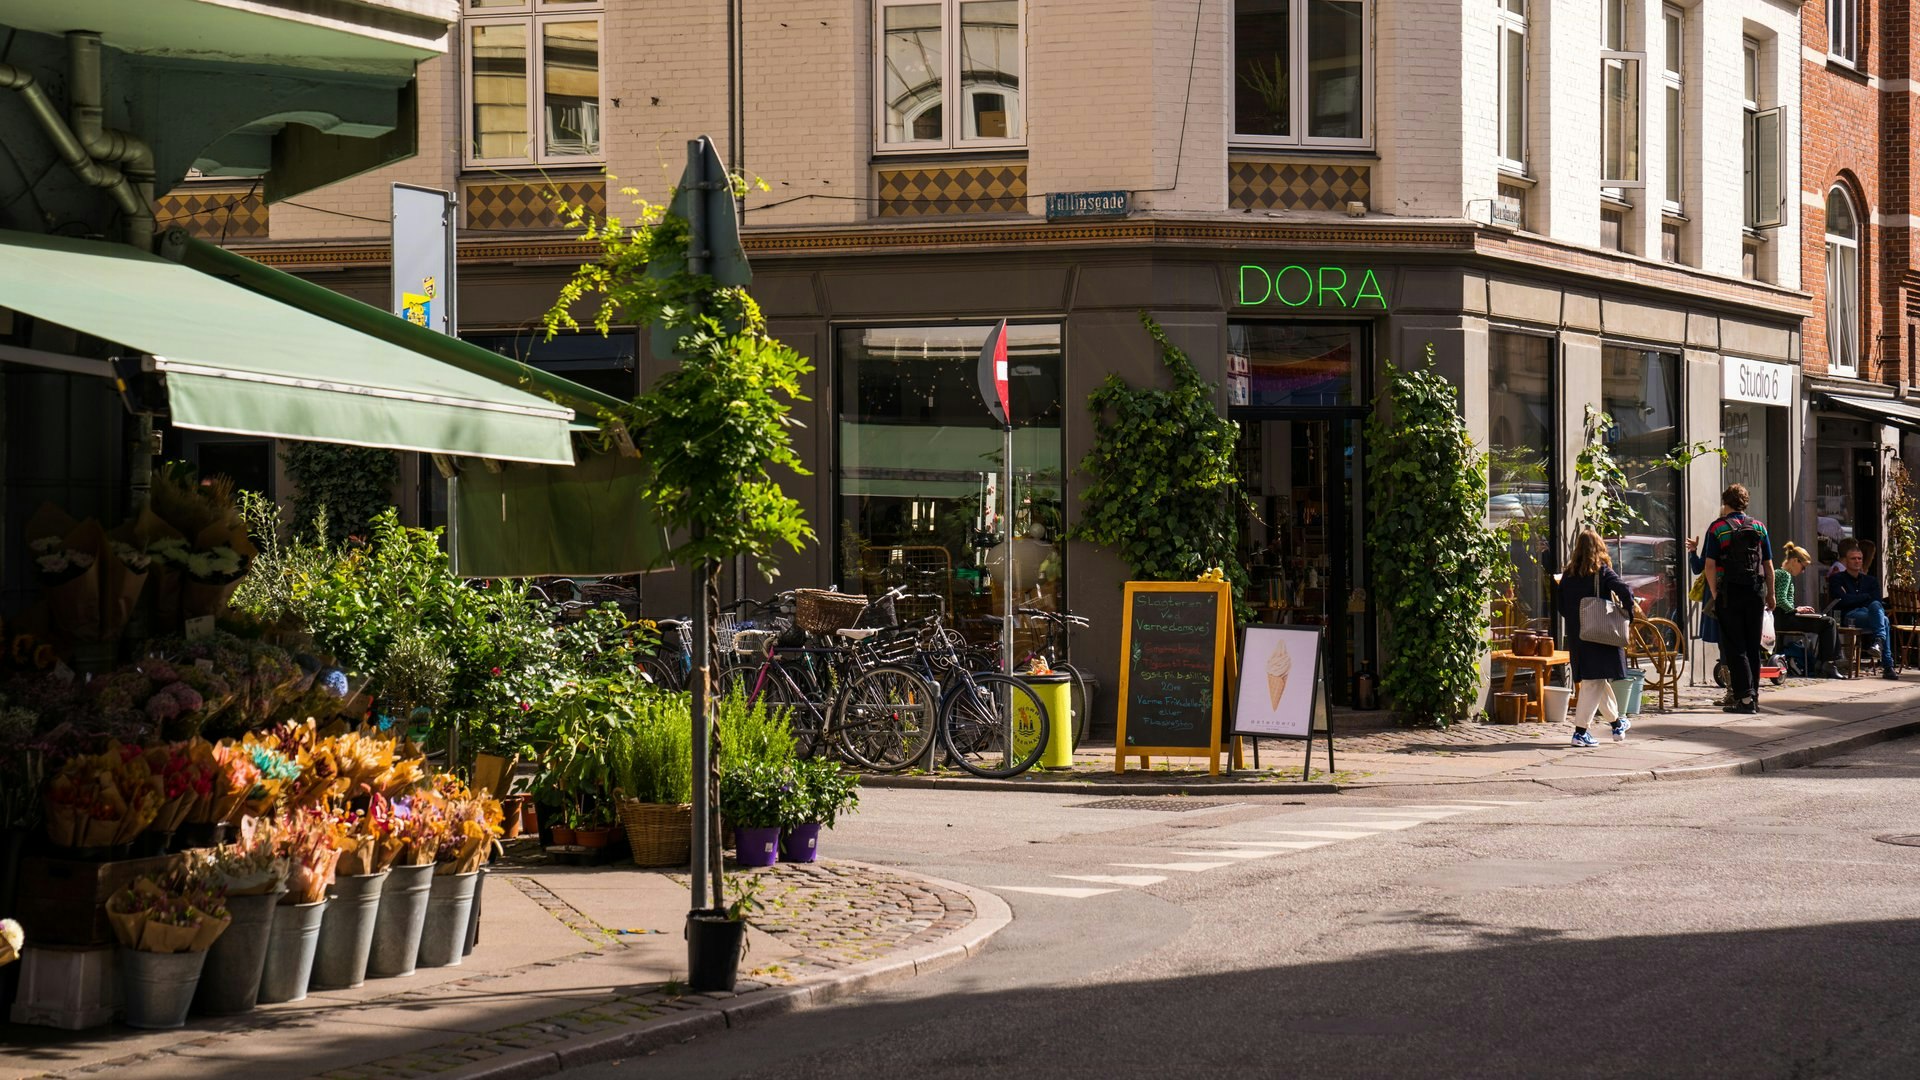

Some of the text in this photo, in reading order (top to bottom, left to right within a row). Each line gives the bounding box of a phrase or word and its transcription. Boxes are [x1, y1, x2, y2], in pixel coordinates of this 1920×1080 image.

[1046, 192, 1124, 214] Tullinsgade
[1240, 265, 1387, 309] DORA
[1739, 363, 1779, 400] Studio 6
[1725, 412, 1750, 449] PRO
[1726, 452, 1760, 488] GRAM
